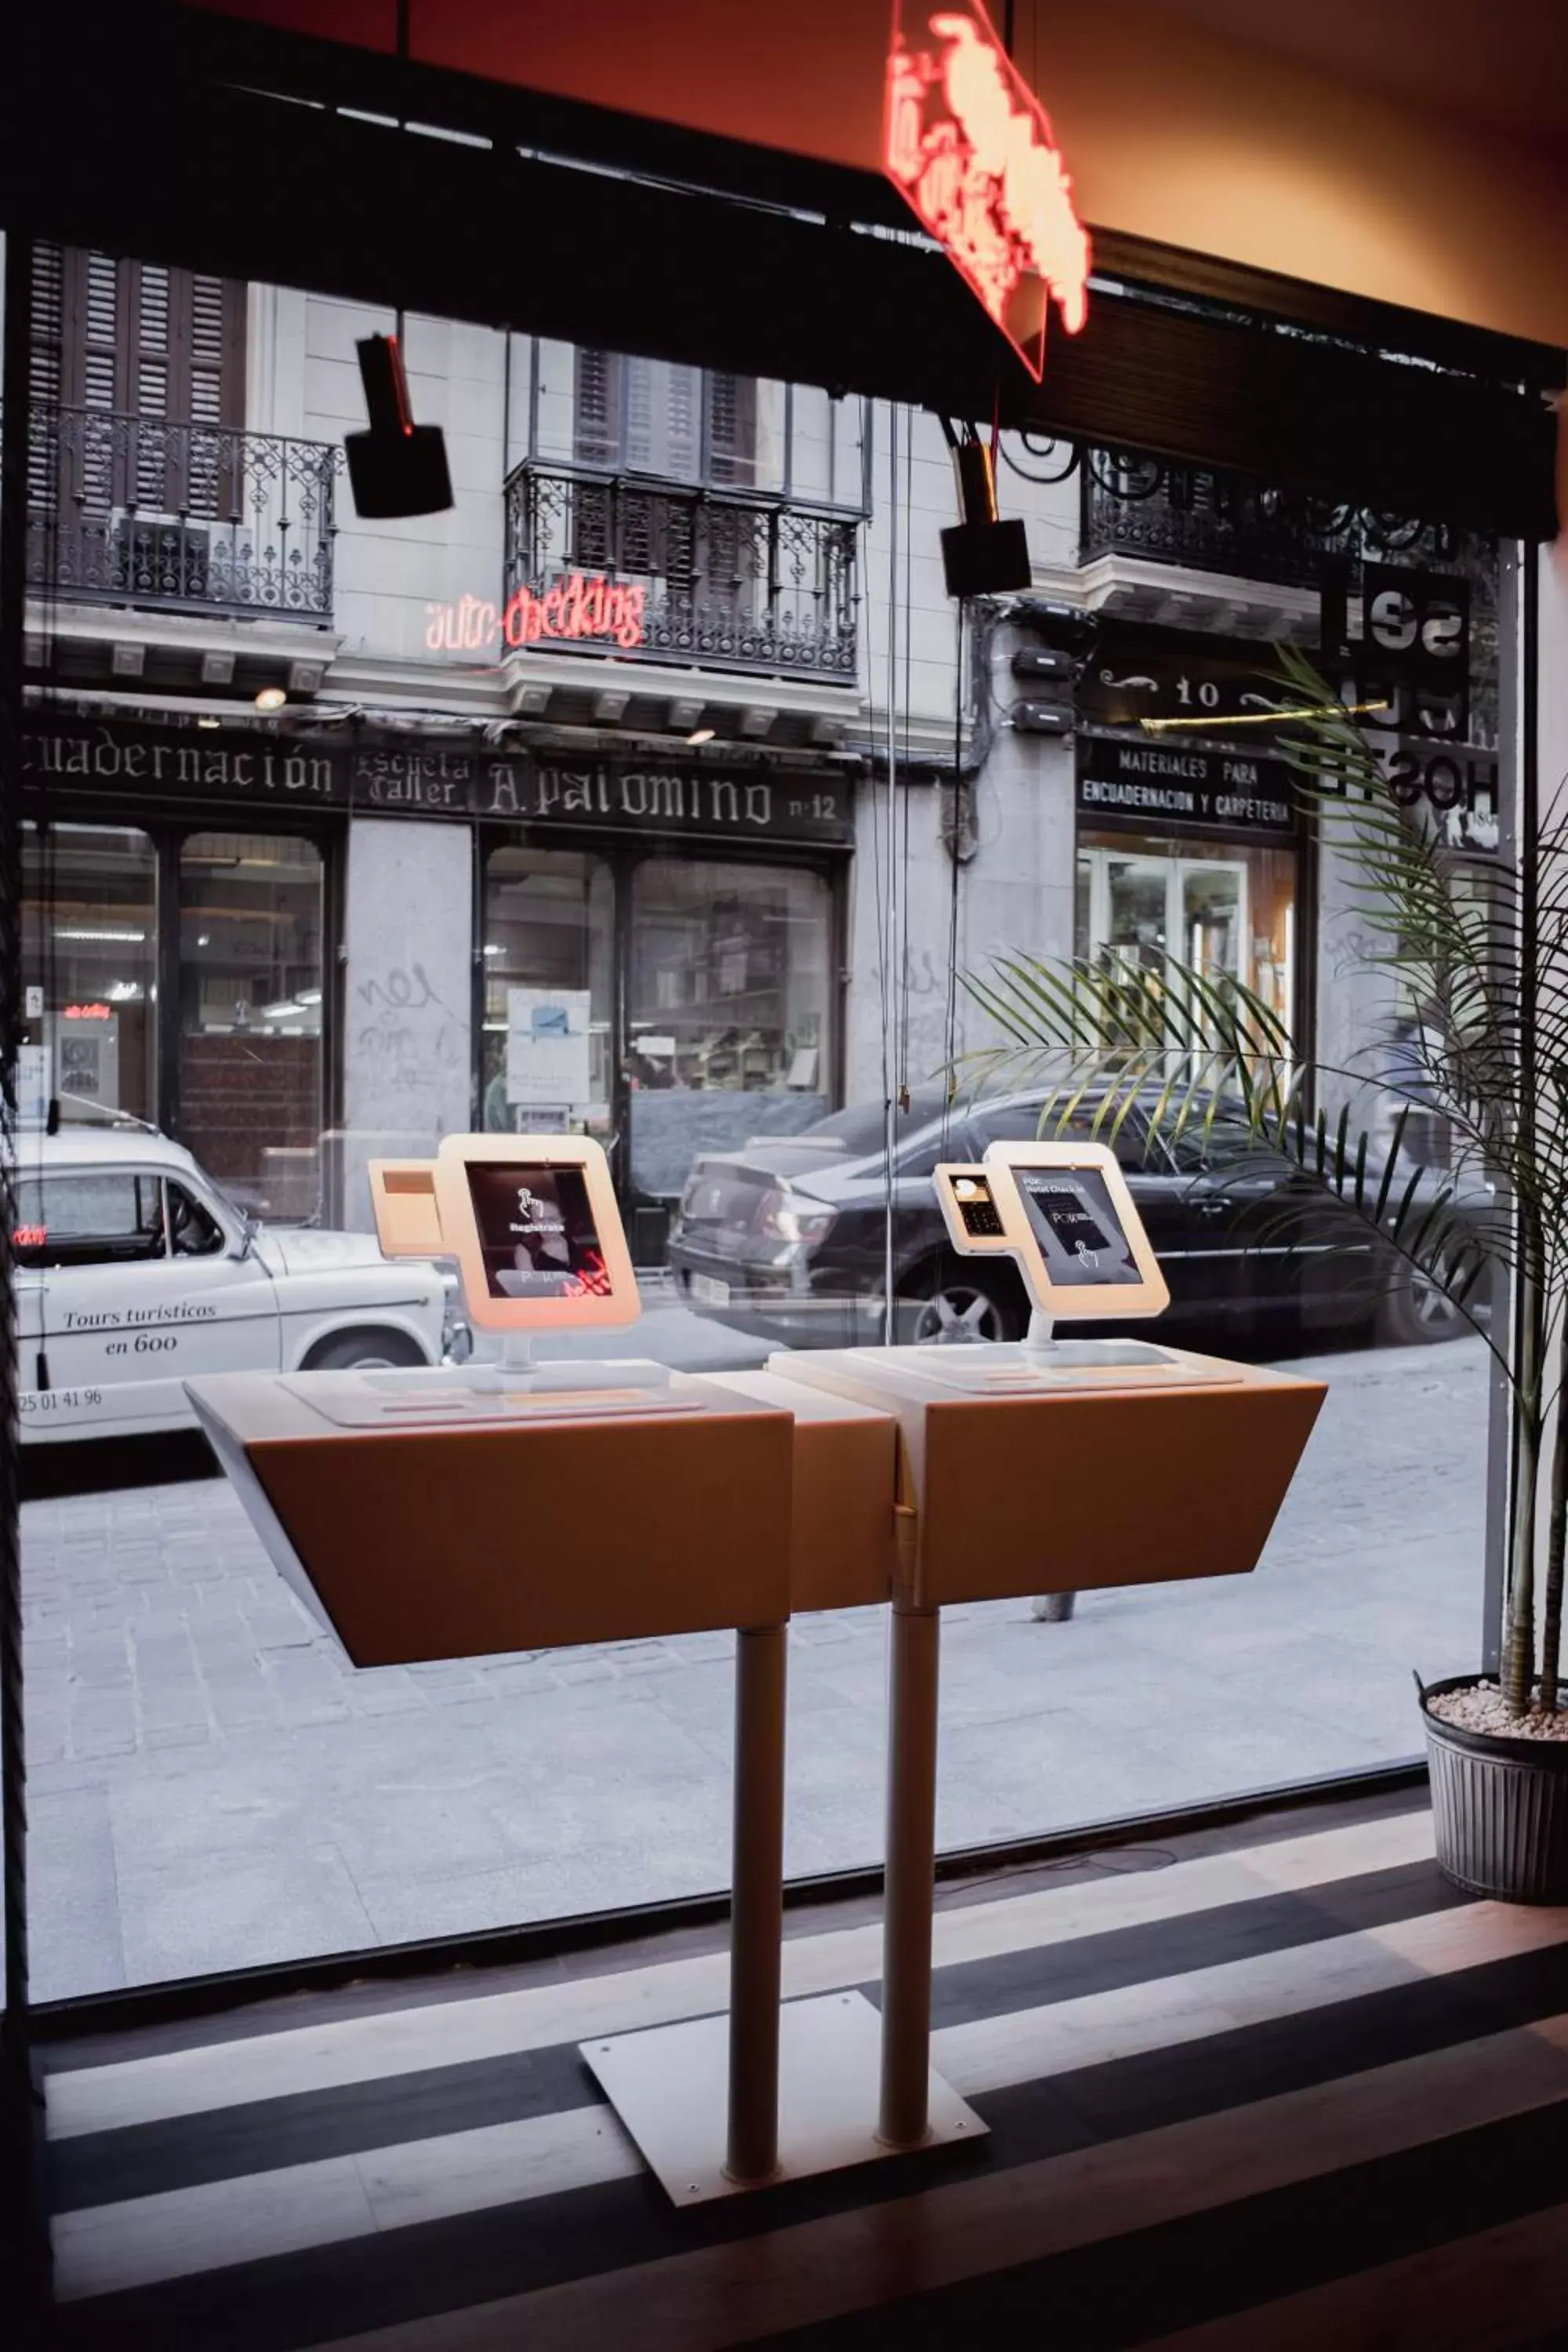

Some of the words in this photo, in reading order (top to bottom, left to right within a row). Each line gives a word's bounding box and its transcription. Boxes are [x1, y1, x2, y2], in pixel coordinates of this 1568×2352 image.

[1176, 675, 1219, 707] 10
[1119, 749, 1207, 779] MATERIALES
[1222, 761, 1258, 785] PARA
[368, 774, 457, 804] Taller
[1082, 779, 1195, 811] ENCUADERNACION
[1200, 793, 1211, 814] Y
[1215, 795, 1290, 823] CARPETERIA
[63, 1311, 121, 1328] Tours
[105, 1341, 129, 1356] en
[134, 1333, 178, 1353] 600
[41, 1392, 57, 1410] 01
[63, 1391, 79, 1406] 41
[84, 1388, 102, 1406] 96
